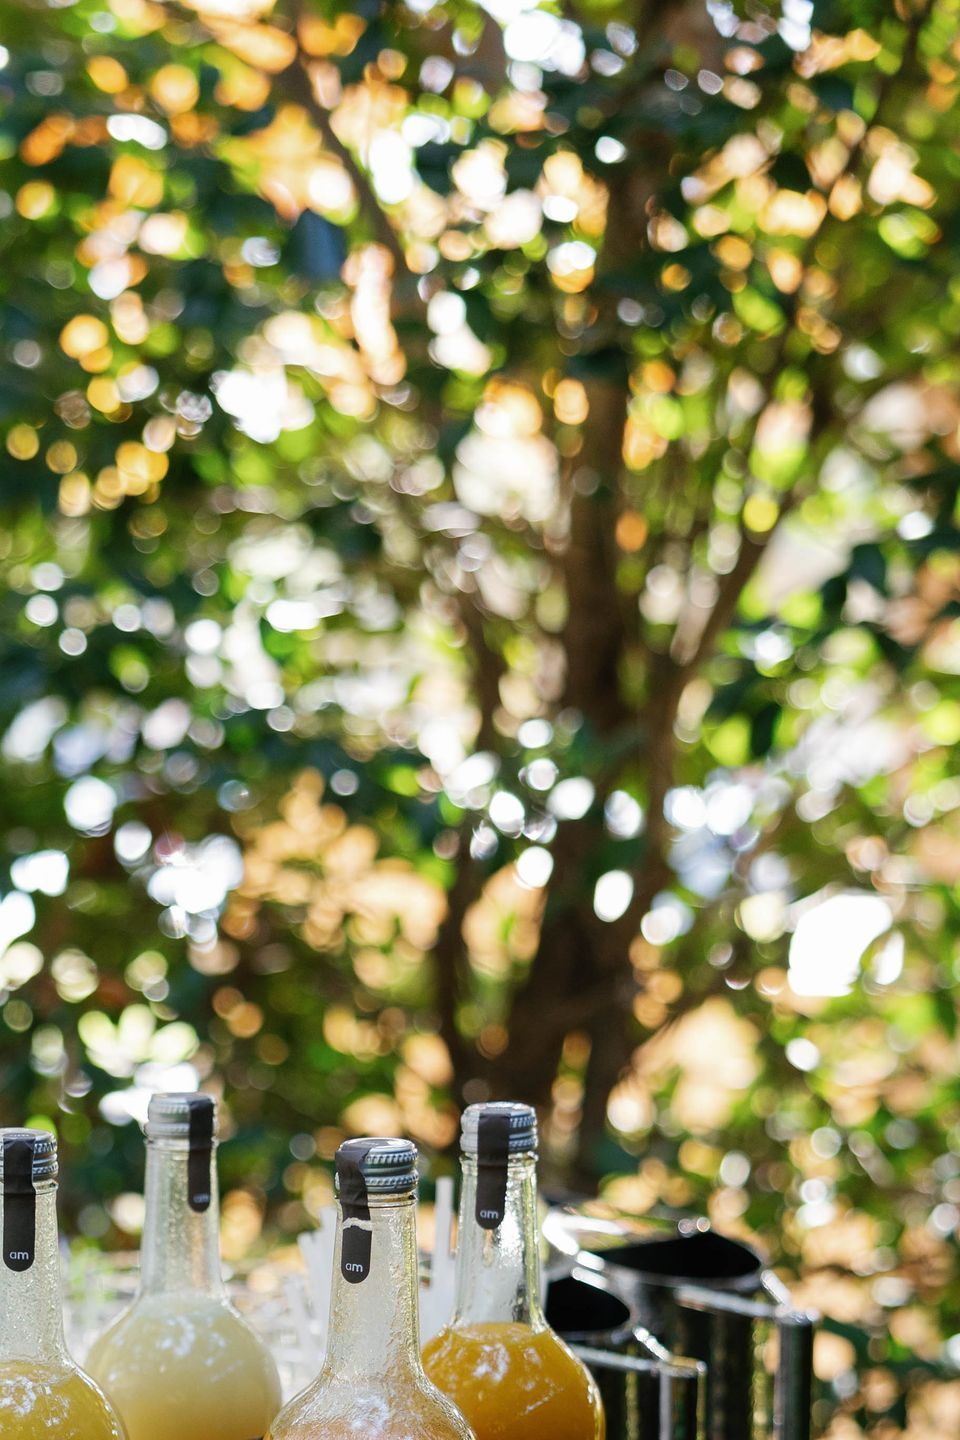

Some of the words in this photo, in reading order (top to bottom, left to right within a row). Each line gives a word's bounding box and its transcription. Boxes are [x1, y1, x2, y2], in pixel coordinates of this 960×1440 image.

[480, 1210, 499, 1219] am
[9, 1250, 29, 1260] am
[345, 1262, 363, 1272] am
